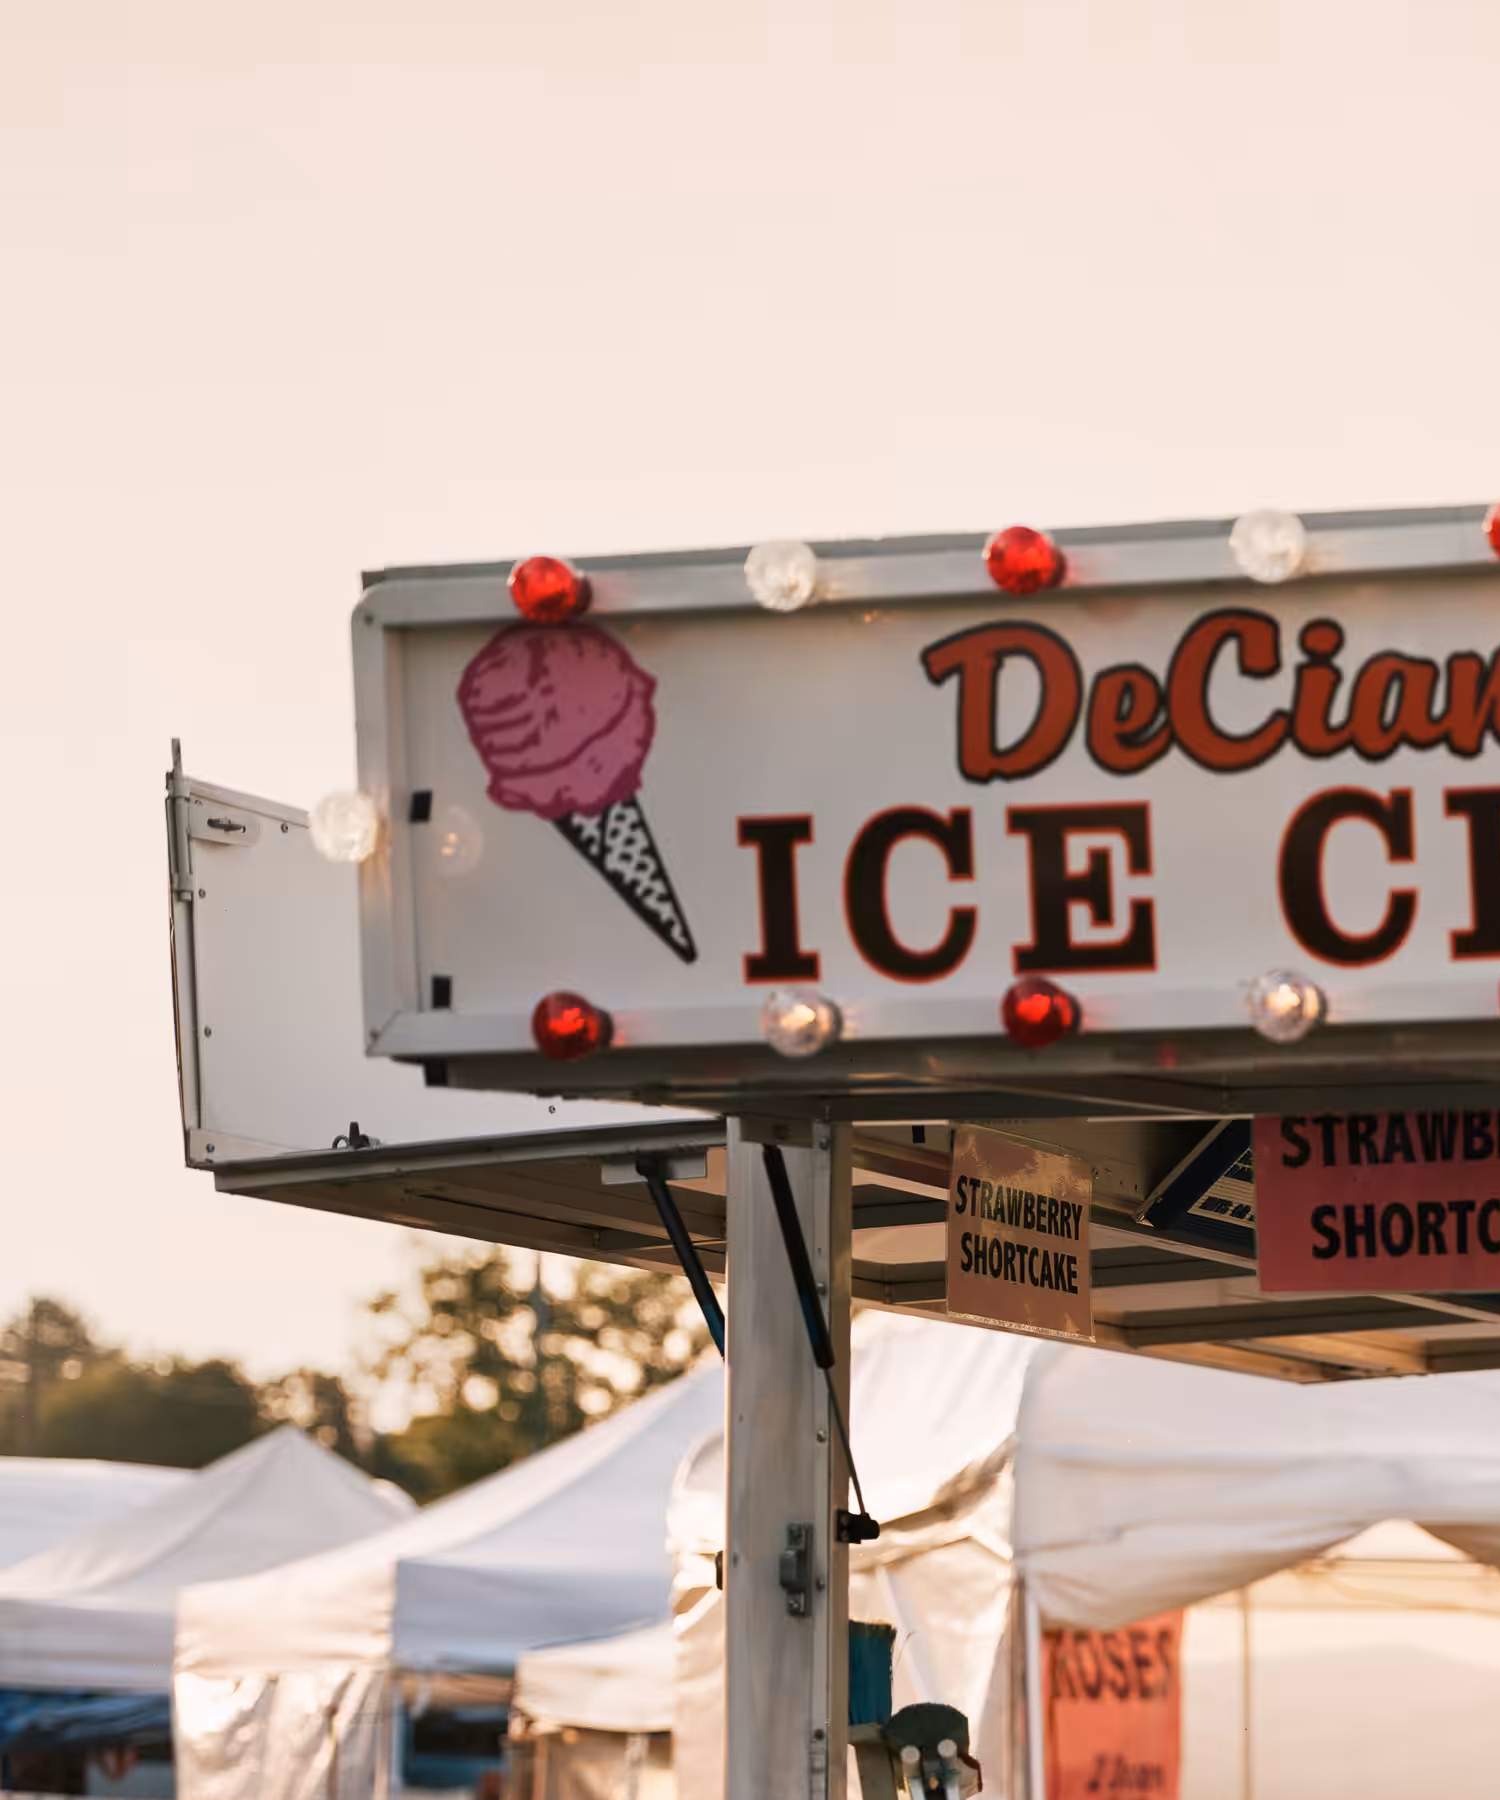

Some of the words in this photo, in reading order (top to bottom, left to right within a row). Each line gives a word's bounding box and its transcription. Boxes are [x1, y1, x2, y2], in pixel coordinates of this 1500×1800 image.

[736, 802, 1157, 984] ICE
[955, 1174, 1083, 1240] STRAWBERRY
[960, 1231, 1079, 1294] SHORTCAKE
